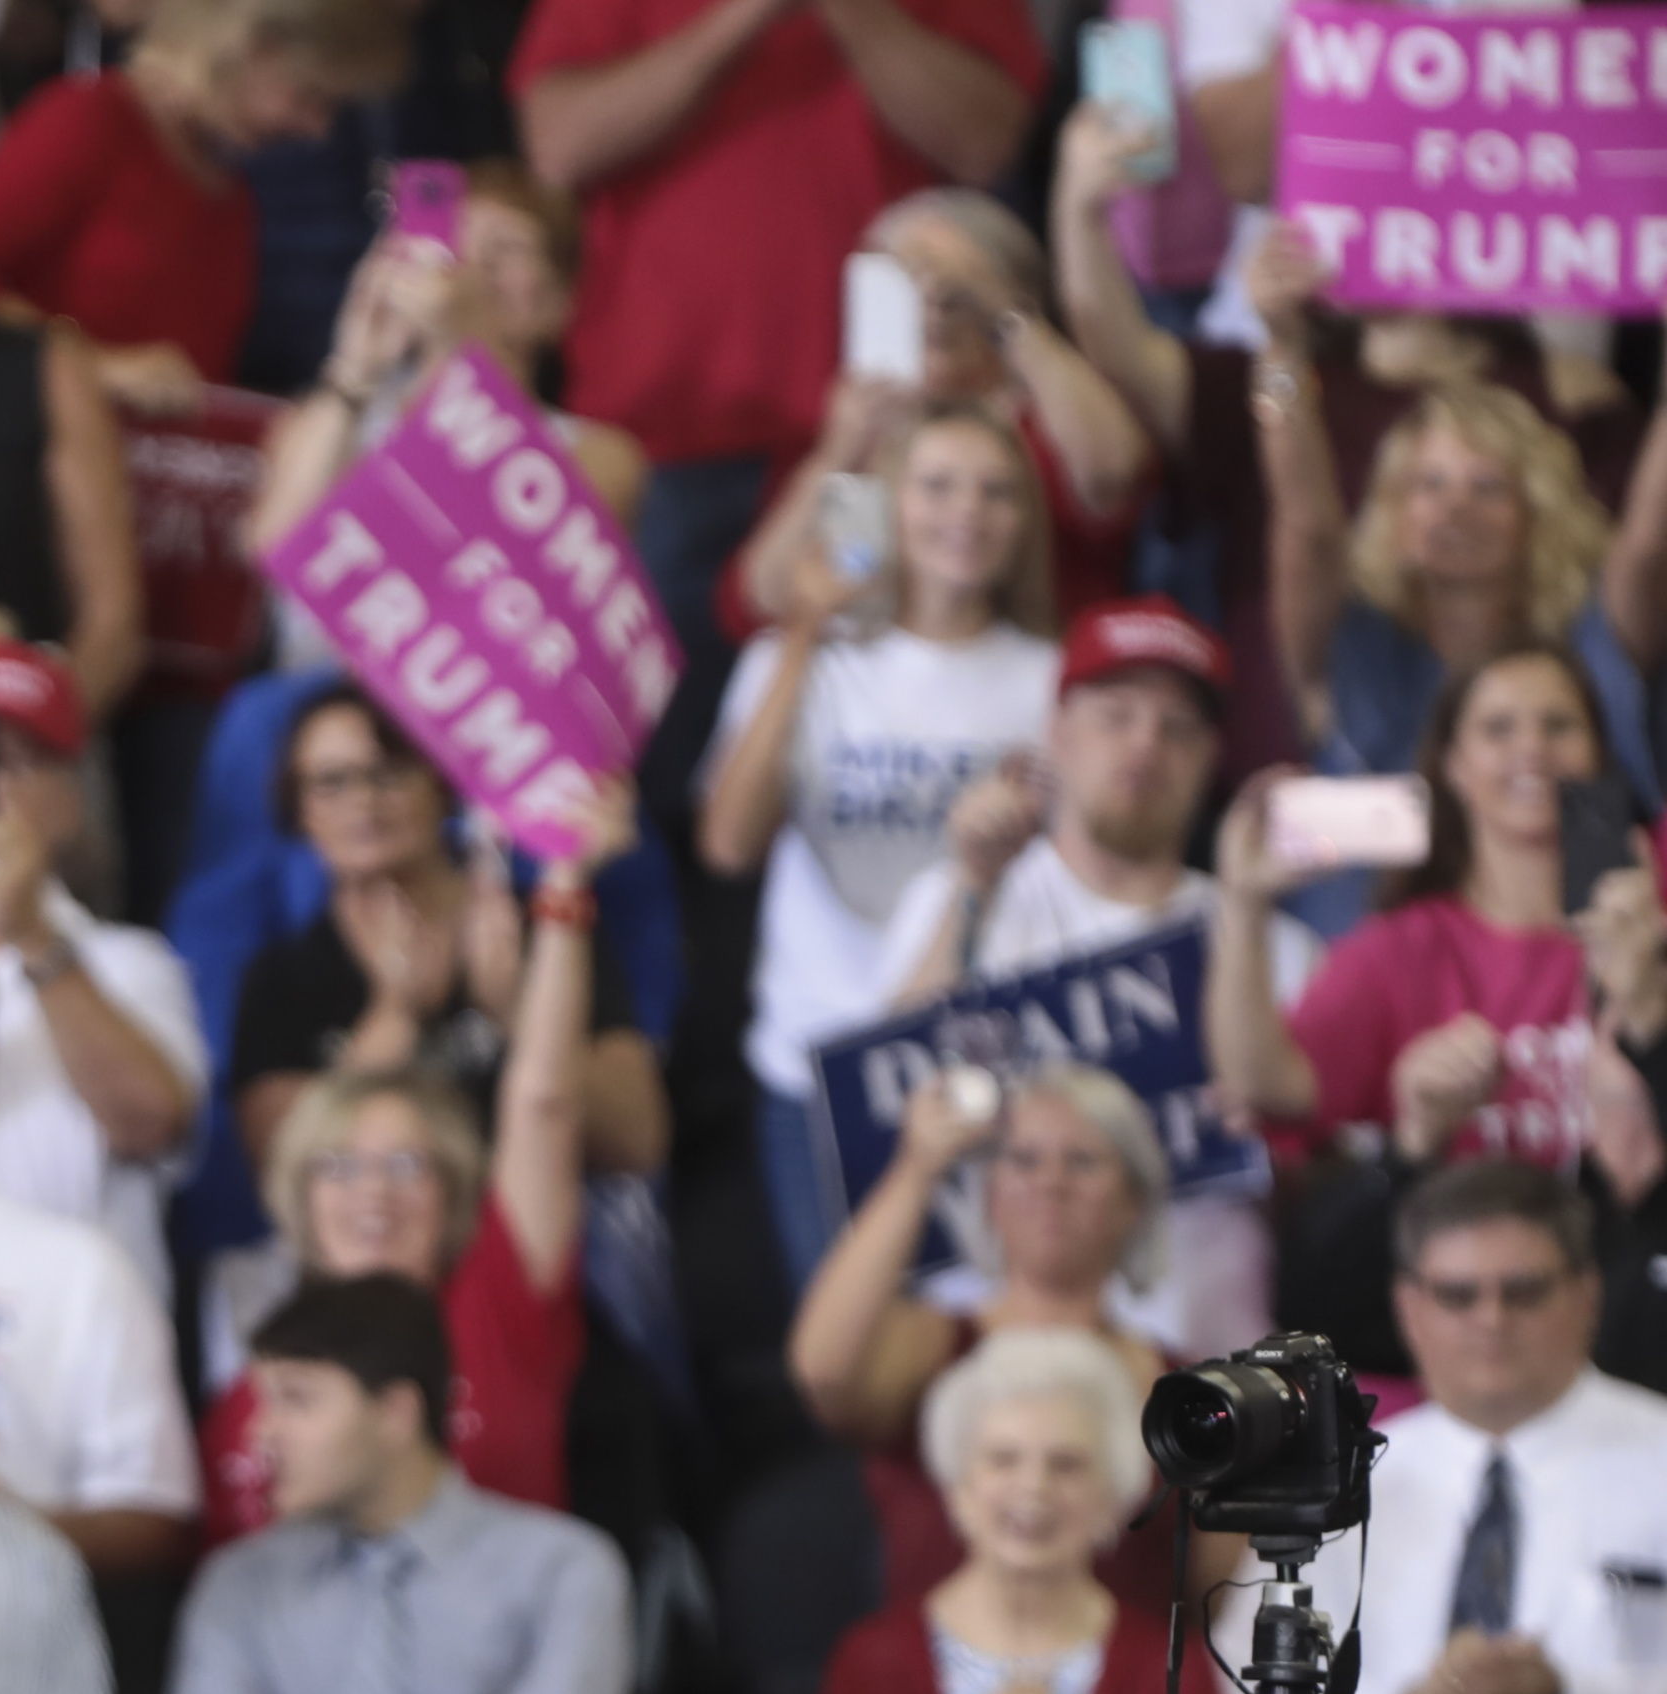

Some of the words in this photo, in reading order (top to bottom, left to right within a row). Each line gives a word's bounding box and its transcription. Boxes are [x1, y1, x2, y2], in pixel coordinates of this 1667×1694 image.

[1413, 127, 1580, 194] FOR
[441, 537, 578, 686] FOR
[1255, 1350, 1284, 1358] SONY
